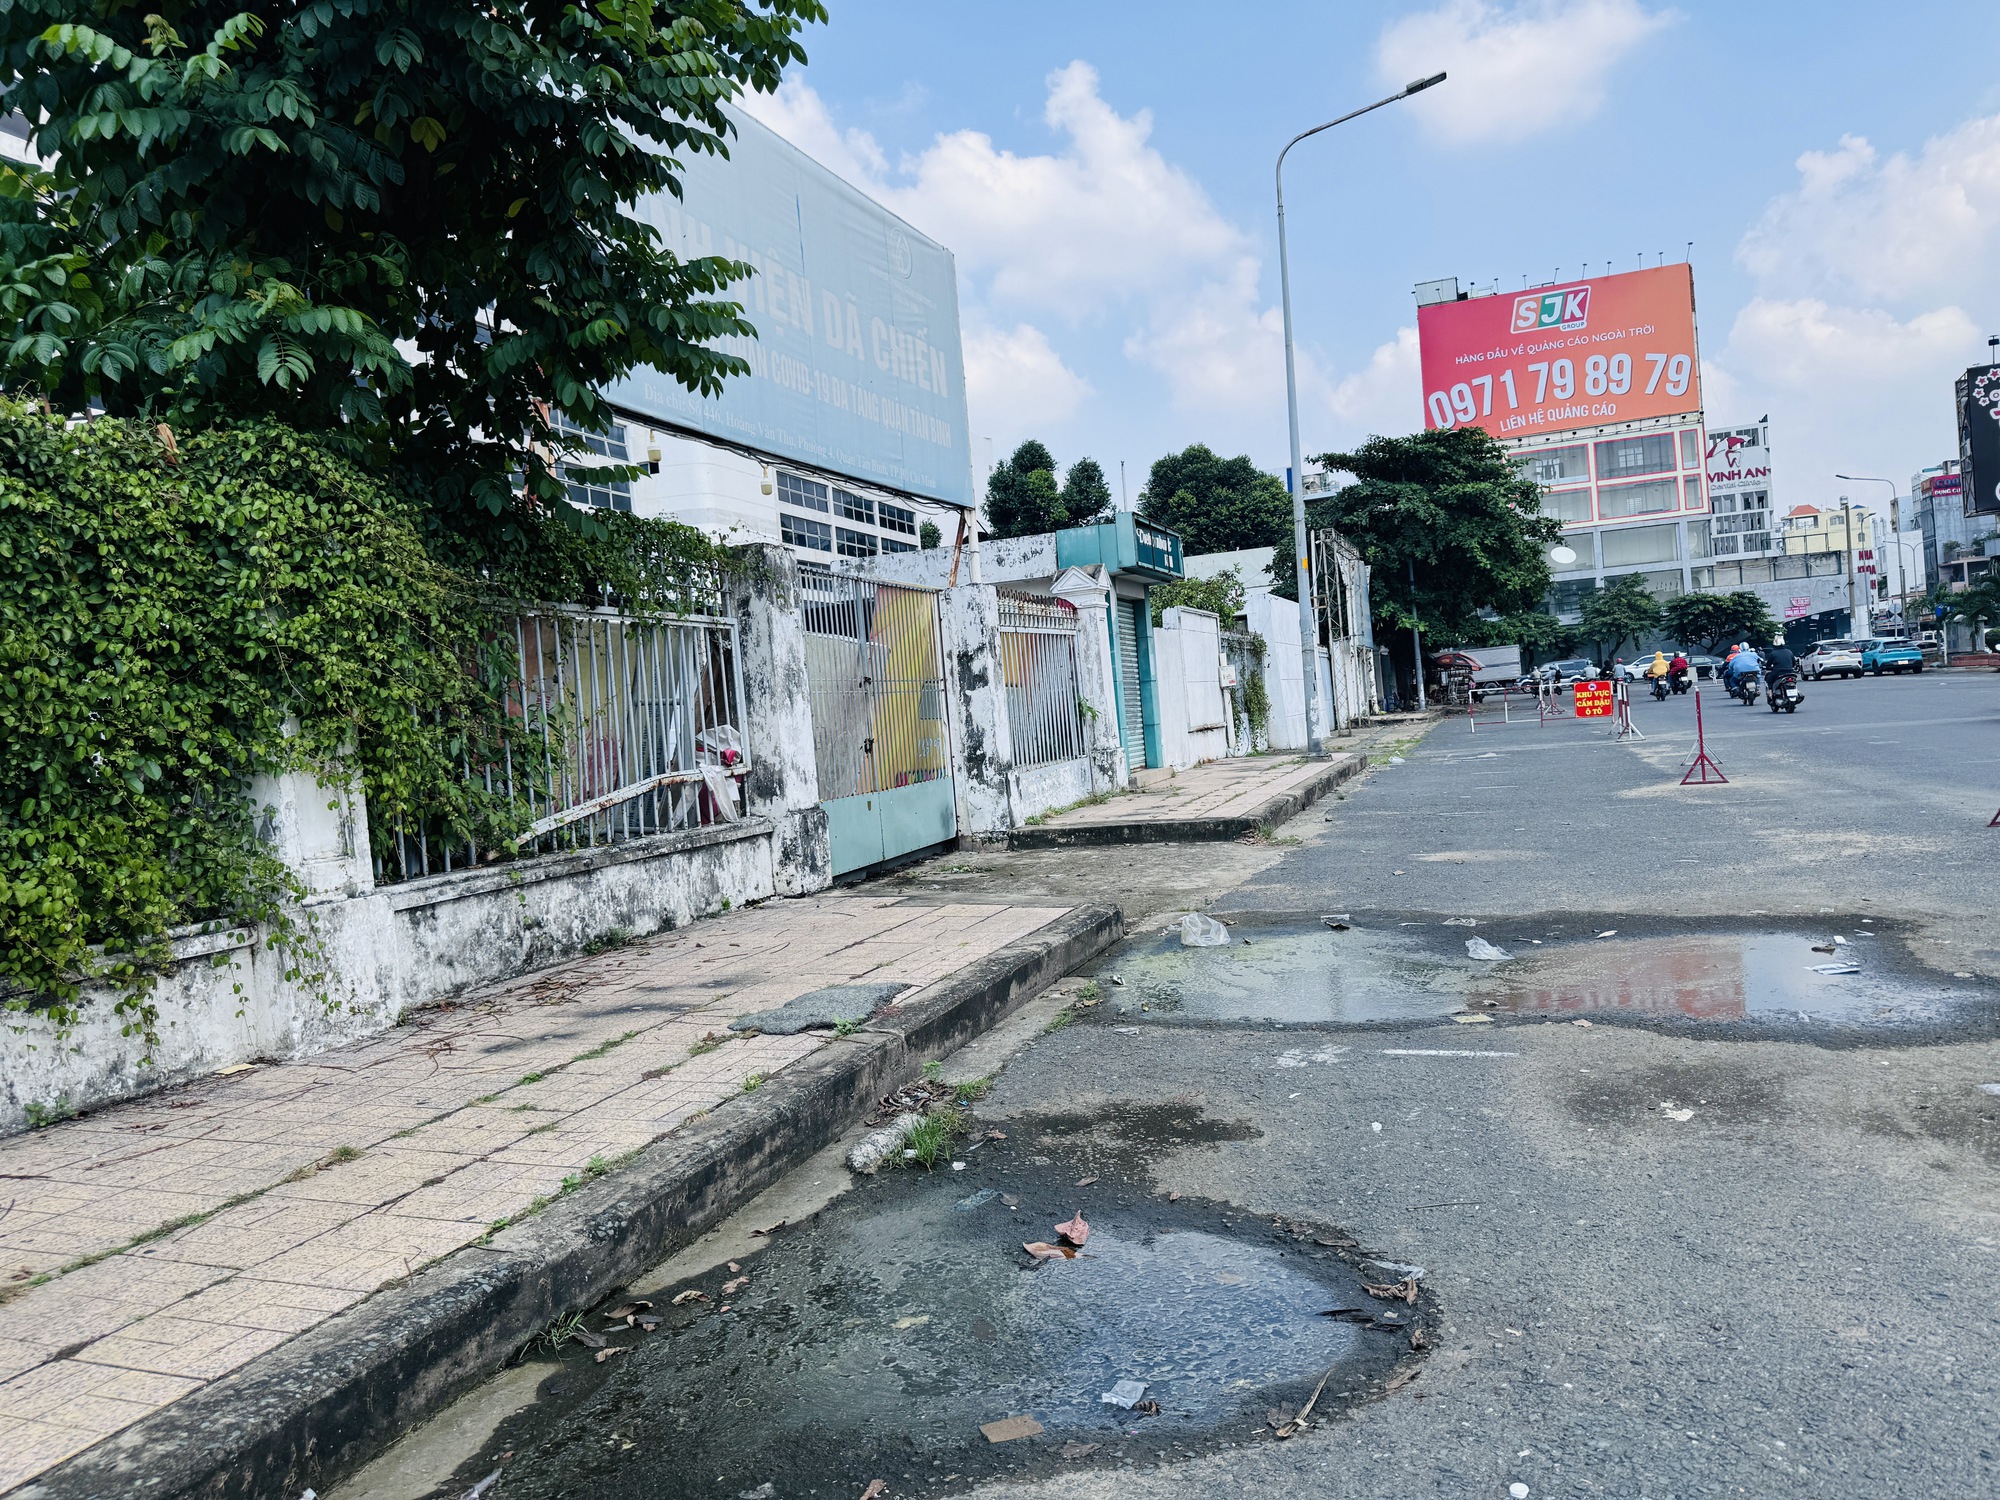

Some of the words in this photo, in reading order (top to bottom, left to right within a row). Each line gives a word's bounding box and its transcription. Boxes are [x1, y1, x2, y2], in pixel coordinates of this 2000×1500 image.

[1516, 291, 1587, 328] SJK
[1561, 321, 1585, 330] GROUP
[822, 289, 865, 362] DÃ
[871, 316, 948, 398] CHIẾN
[1455, 351, 1485, 365] HÀNG
[1527, 338, 1565, 355] QUẢNG
[1568, 333, 1589, 347] CÁO
[1592, 326, 1626, 342] NGOÀI
[1628, 324, 1655, 337] TRỜI
[771, 352, 830, 404] COVID-19
[881, 396, 910, 438] QUẬN
[910, 405, 930, 441] TÂN
[930, 411, 952, 449] BÌNH
[1427, 369, 1520, 429] 0971
[1527, 358, 1575, 405] 79
[1584, 353, 1632, 397] 89
[1643, 353, 1692, 397] 79
[643, 383, 664, 407] Địa
[688, 398, 702, 417] Số
[726, 411, 756, 438] Hoàng
[757, 420, 775, 440] Văn
[1500, 414, 1527, 432] LIÊN
[1528, 408, 1545, 425] HỆ
[1547, 402, 1589, 424] QUẢNG
[1592, 402, 1616, 416] CÁO
[1707, 469, 1742, 483] VINH
[1743, 466, 1767, 479] AN
[1577, 699, 1592, 707] CẤM
